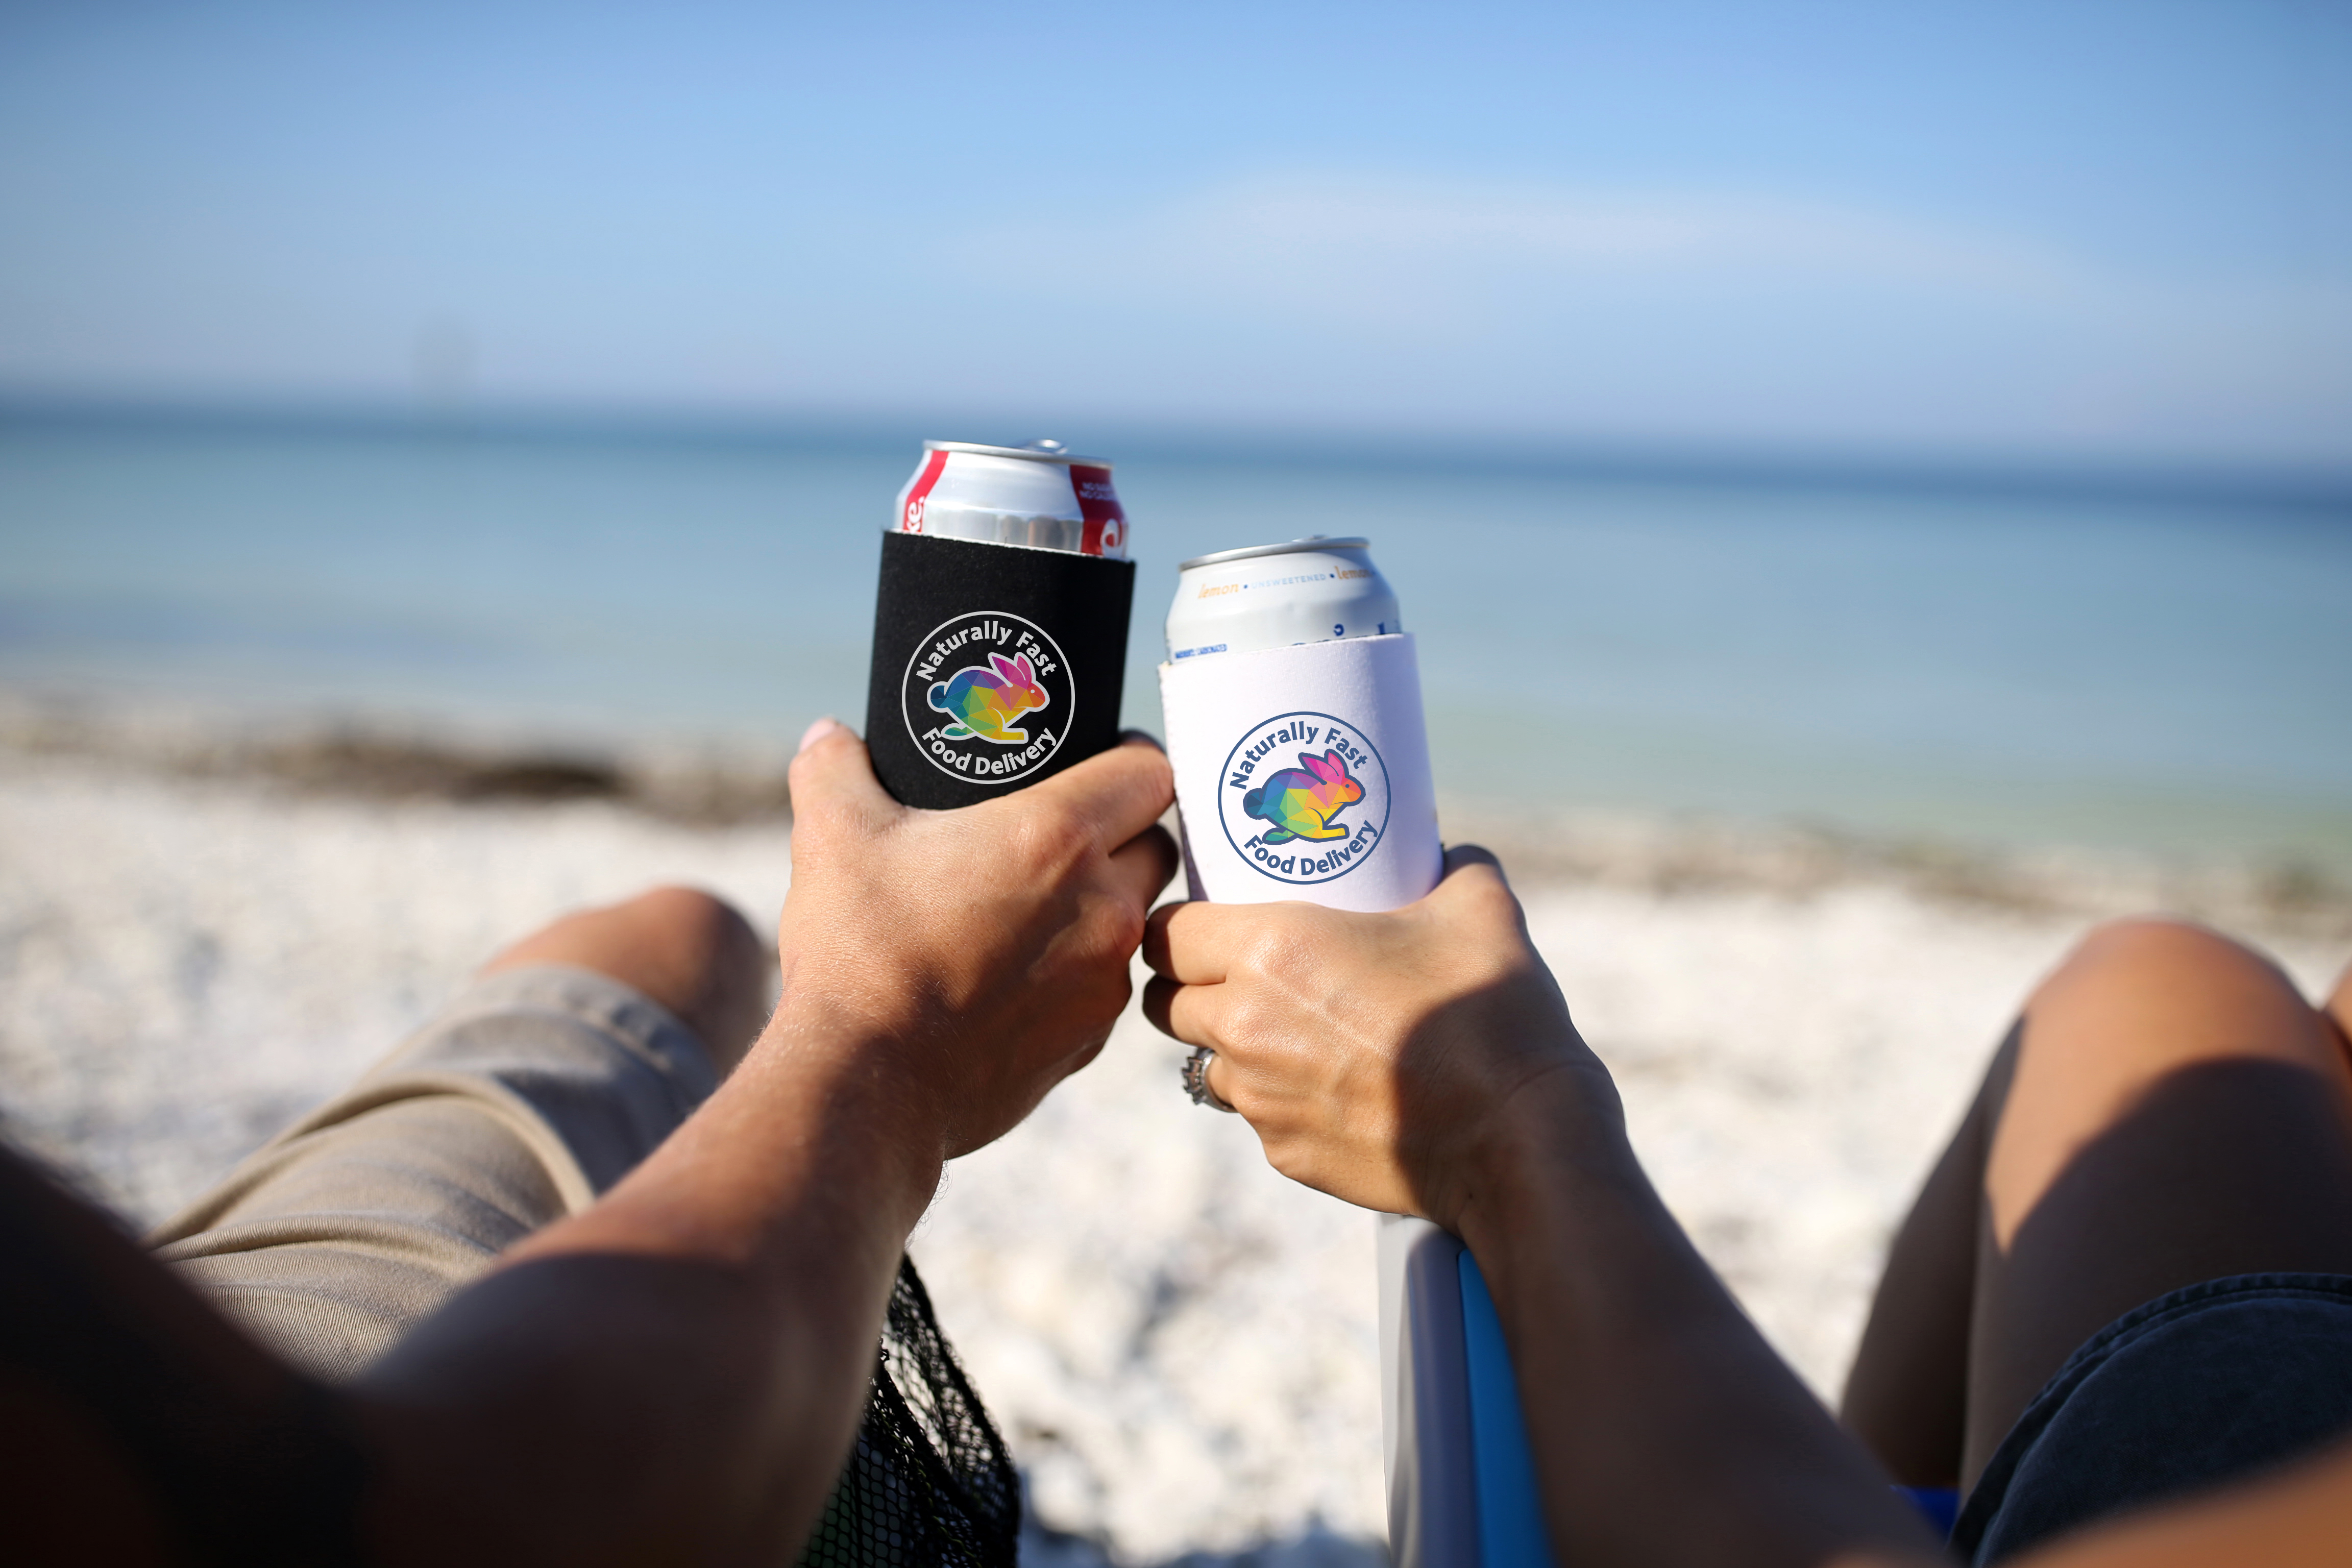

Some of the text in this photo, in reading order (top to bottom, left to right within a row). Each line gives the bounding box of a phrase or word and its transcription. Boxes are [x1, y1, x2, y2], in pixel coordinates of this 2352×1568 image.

[1197, 566, 1373, 599] lemon UNSWEETENED lemon
[916, 621, 1057, 681] Naturally Fast
[922, 727, 1057, 775] Food Delivery
[1230, 721, 1368, 790] Naturally Fast
[1244, 820, 1378, 875] Food Delivery
